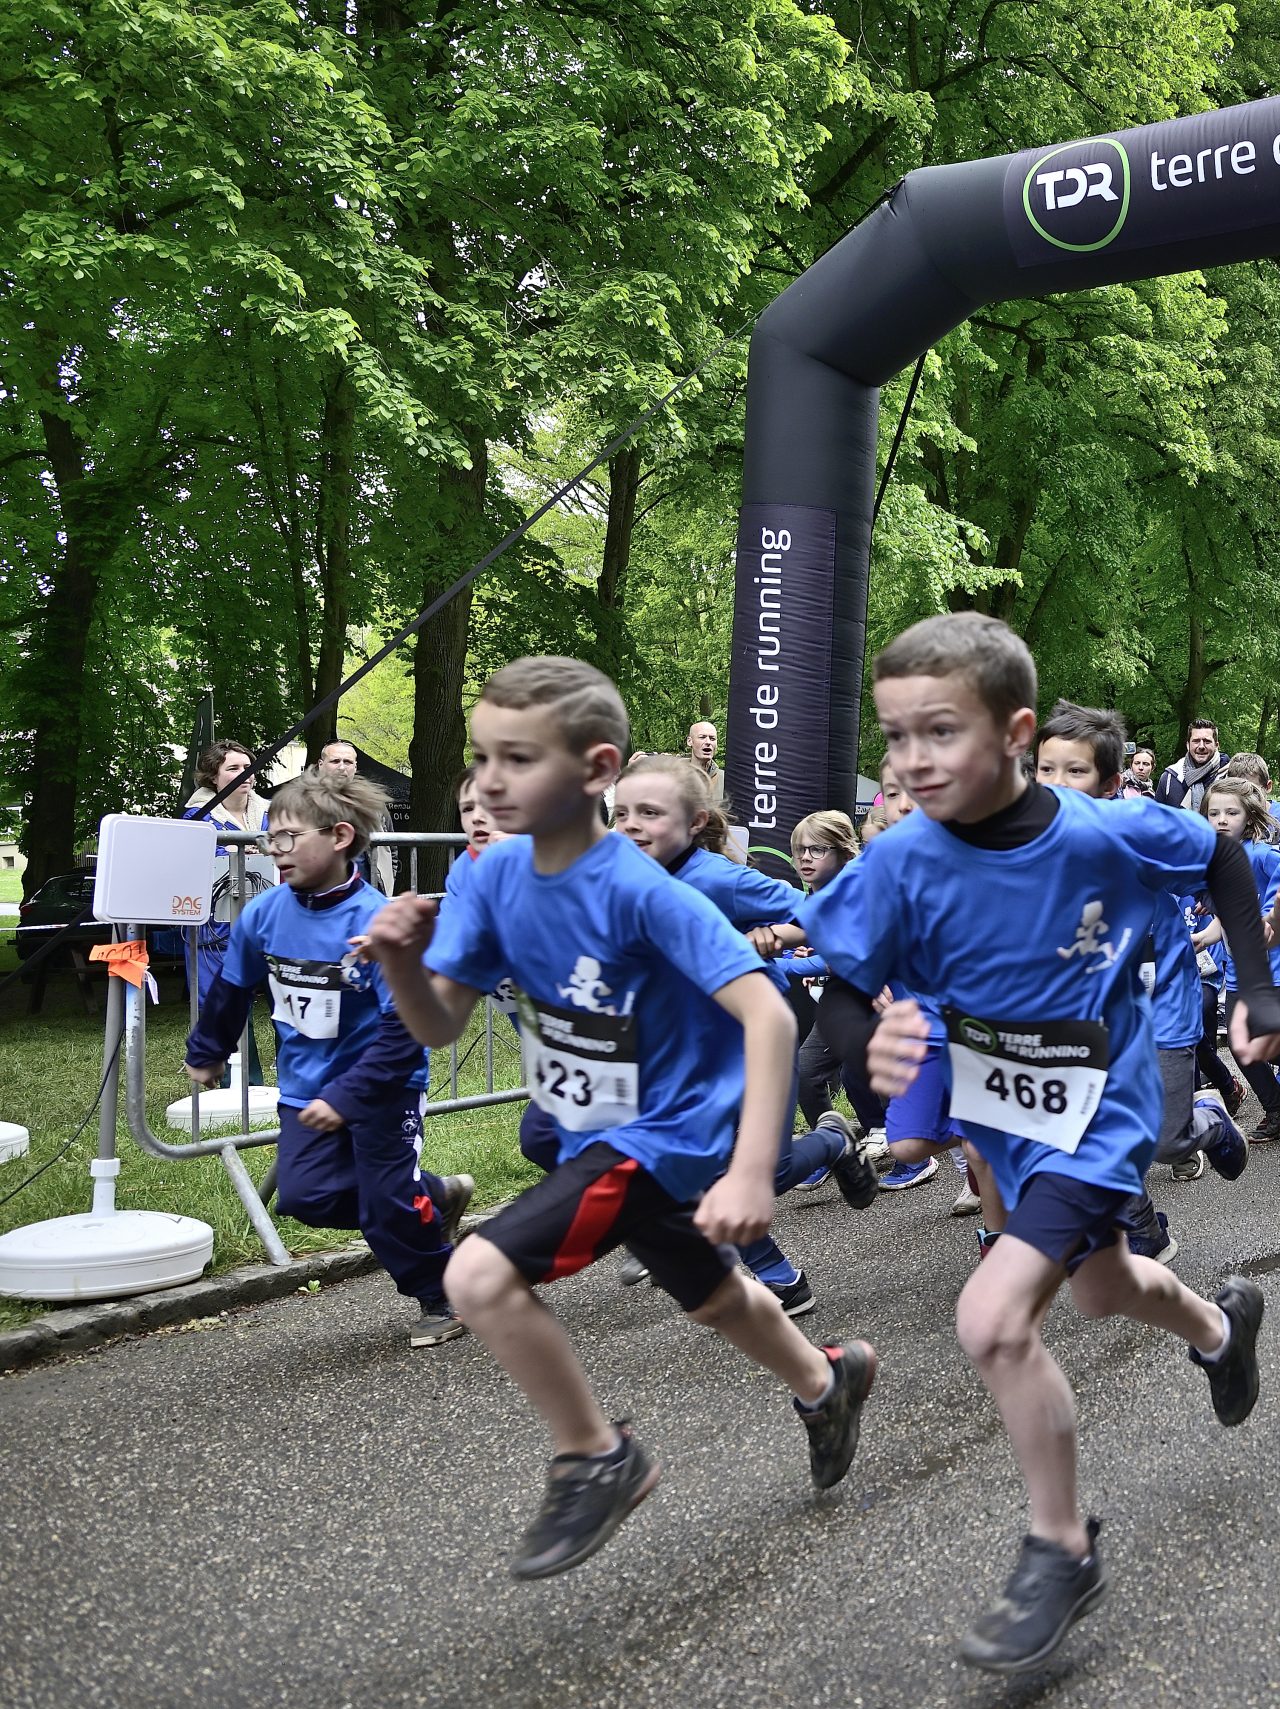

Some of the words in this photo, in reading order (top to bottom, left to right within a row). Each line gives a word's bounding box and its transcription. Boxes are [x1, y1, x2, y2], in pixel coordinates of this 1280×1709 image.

[1036, 162, 1120, 211] TDR
[1150, 140, 1257, 191] terre
[753, 527, 792, 671] running
[749, 684, 779, 729] de
[748, 742, 778, 829] terre
[171, 908, 201, 916] SYSTEM
[997, 1031, 1043, 1047] TERRE
[1018, 1045, 1091, 1060] RUNNING
[985, 1067, 1068, 1115] 468
